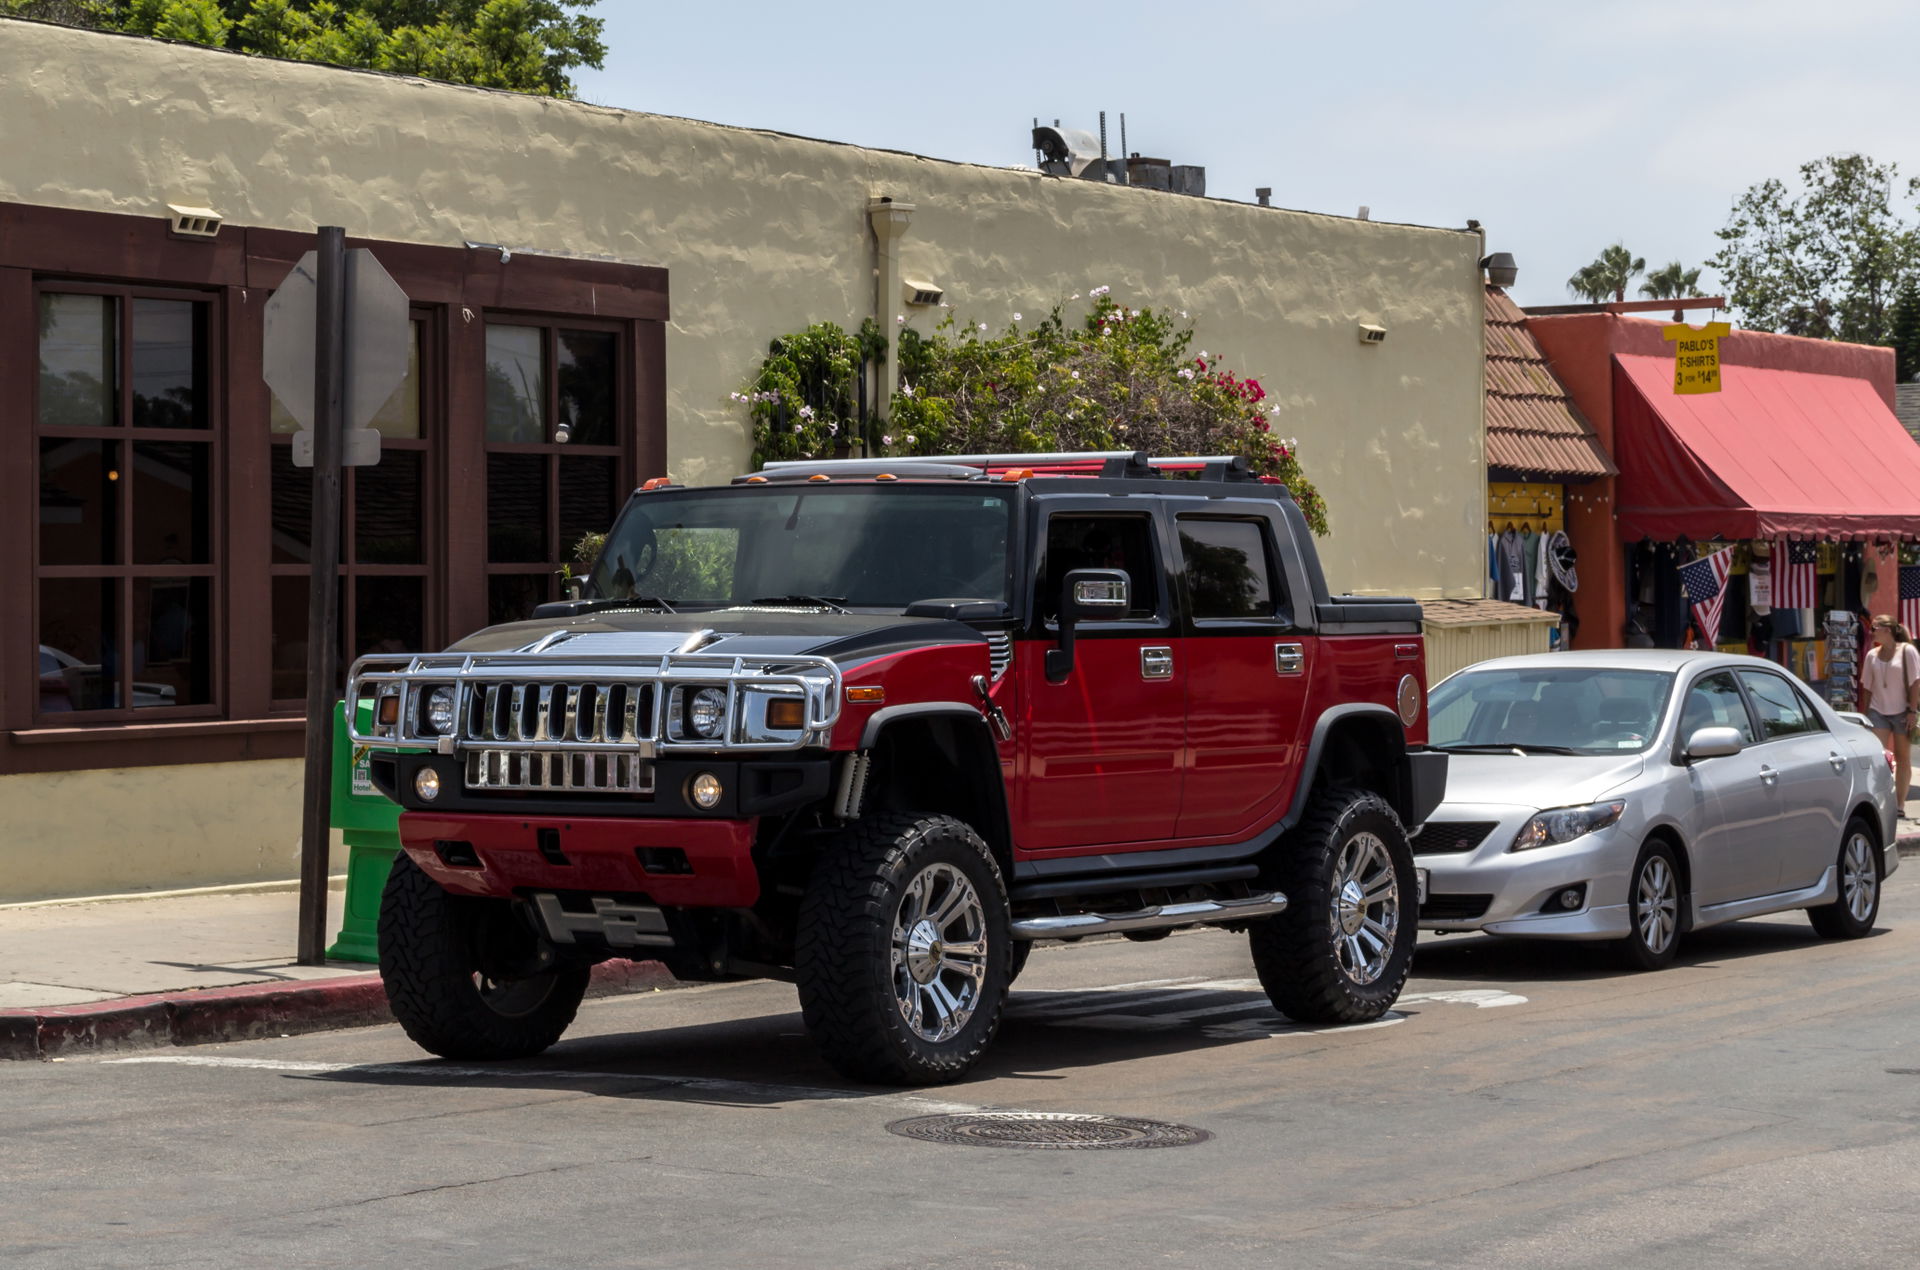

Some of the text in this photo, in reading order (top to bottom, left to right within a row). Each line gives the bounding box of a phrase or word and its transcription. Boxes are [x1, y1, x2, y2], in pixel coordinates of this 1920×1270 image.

[1679, 339, 1714, 352] PABLO'S
[1679, 355, 1716, 367] T-SHIRTS
[1677, 372, 1683, 385] 3
[486, 703, 636, 714] HUMMER
[534, 893, 675, 947] H2
